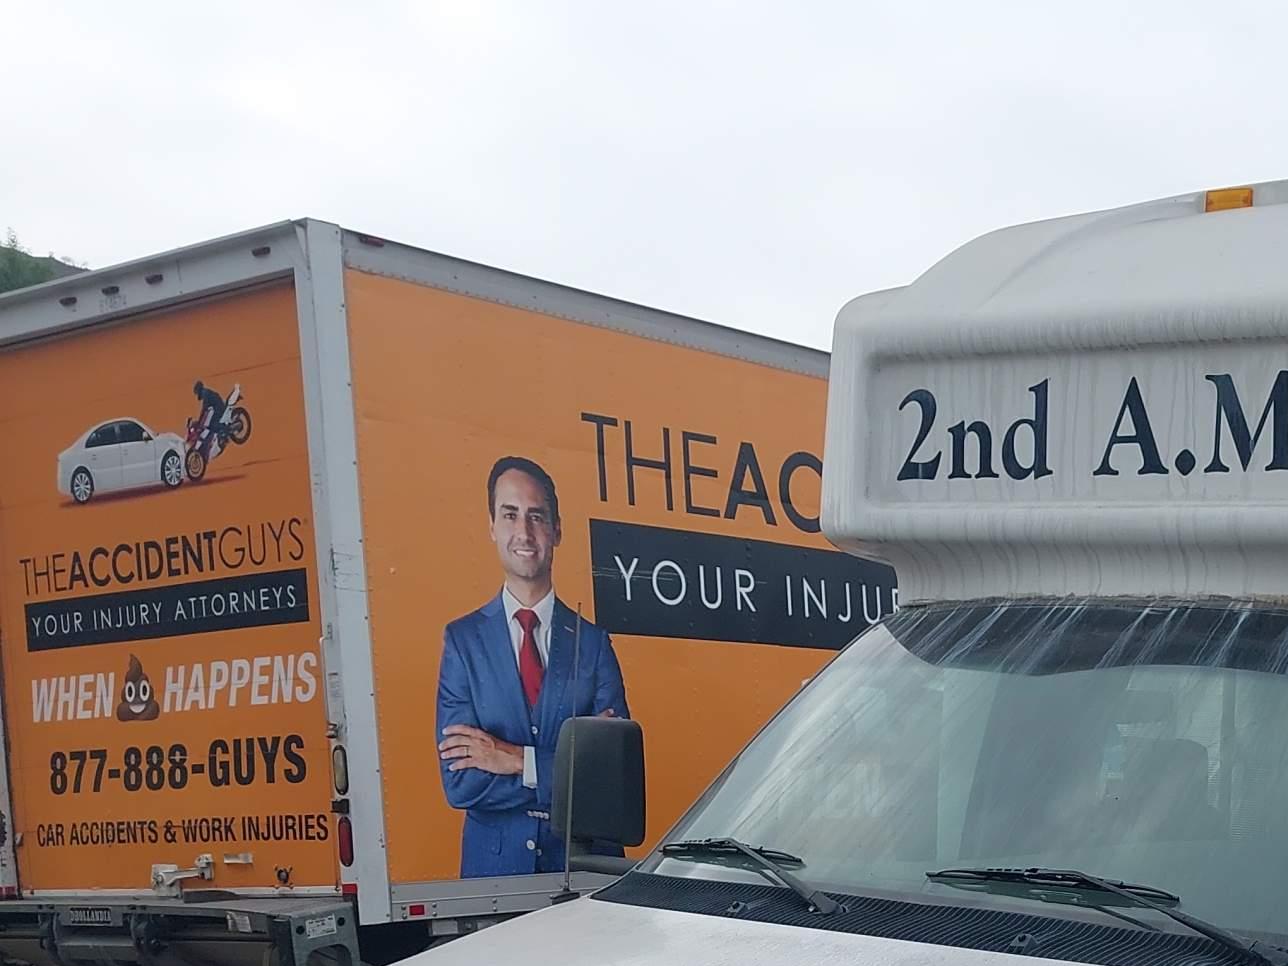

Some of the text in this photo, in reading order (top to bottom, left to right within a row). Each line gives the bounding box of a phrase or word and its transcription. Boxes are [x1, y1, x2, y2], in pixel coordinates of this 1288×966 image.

[897, 377, 1053, 482] 2nd
[32, 585, 296, 637] YOUR INJURY ATTORNEYS
[614, 555, 756, 612] YOUR
[31, 652, 318, 723] WHEN HAPPENS
[50, 734, 307, 796] 877-888-GUYS
[37, 814, 329, 848] CAR ACCIDENTS & WORK INJURIES
